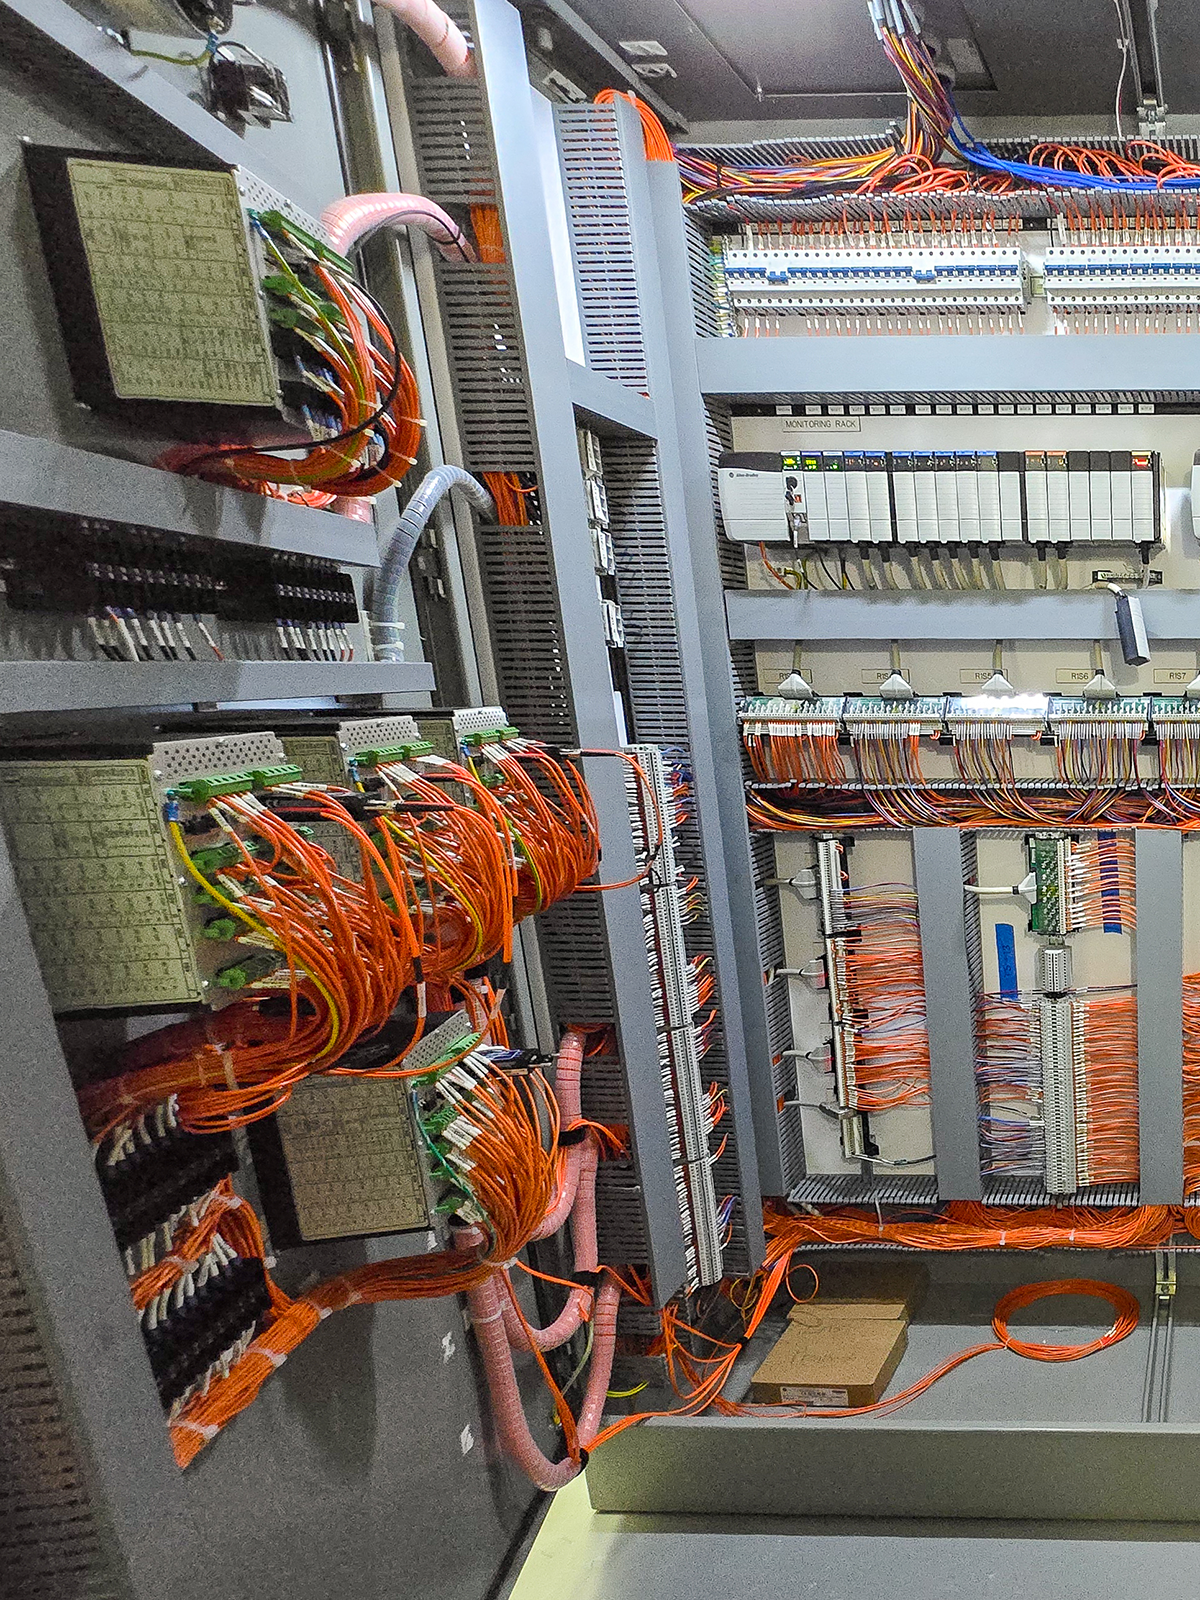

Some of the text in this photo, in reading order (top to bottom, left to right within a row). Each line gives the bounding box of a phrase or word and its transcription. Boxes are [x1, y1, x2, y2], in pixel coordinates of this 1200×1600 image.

[785, 420, 857, 428] MONITORING RACK
[1071, 672, 1089, 680] R1S6
[1169, 672, 1187, 680] R1S7
